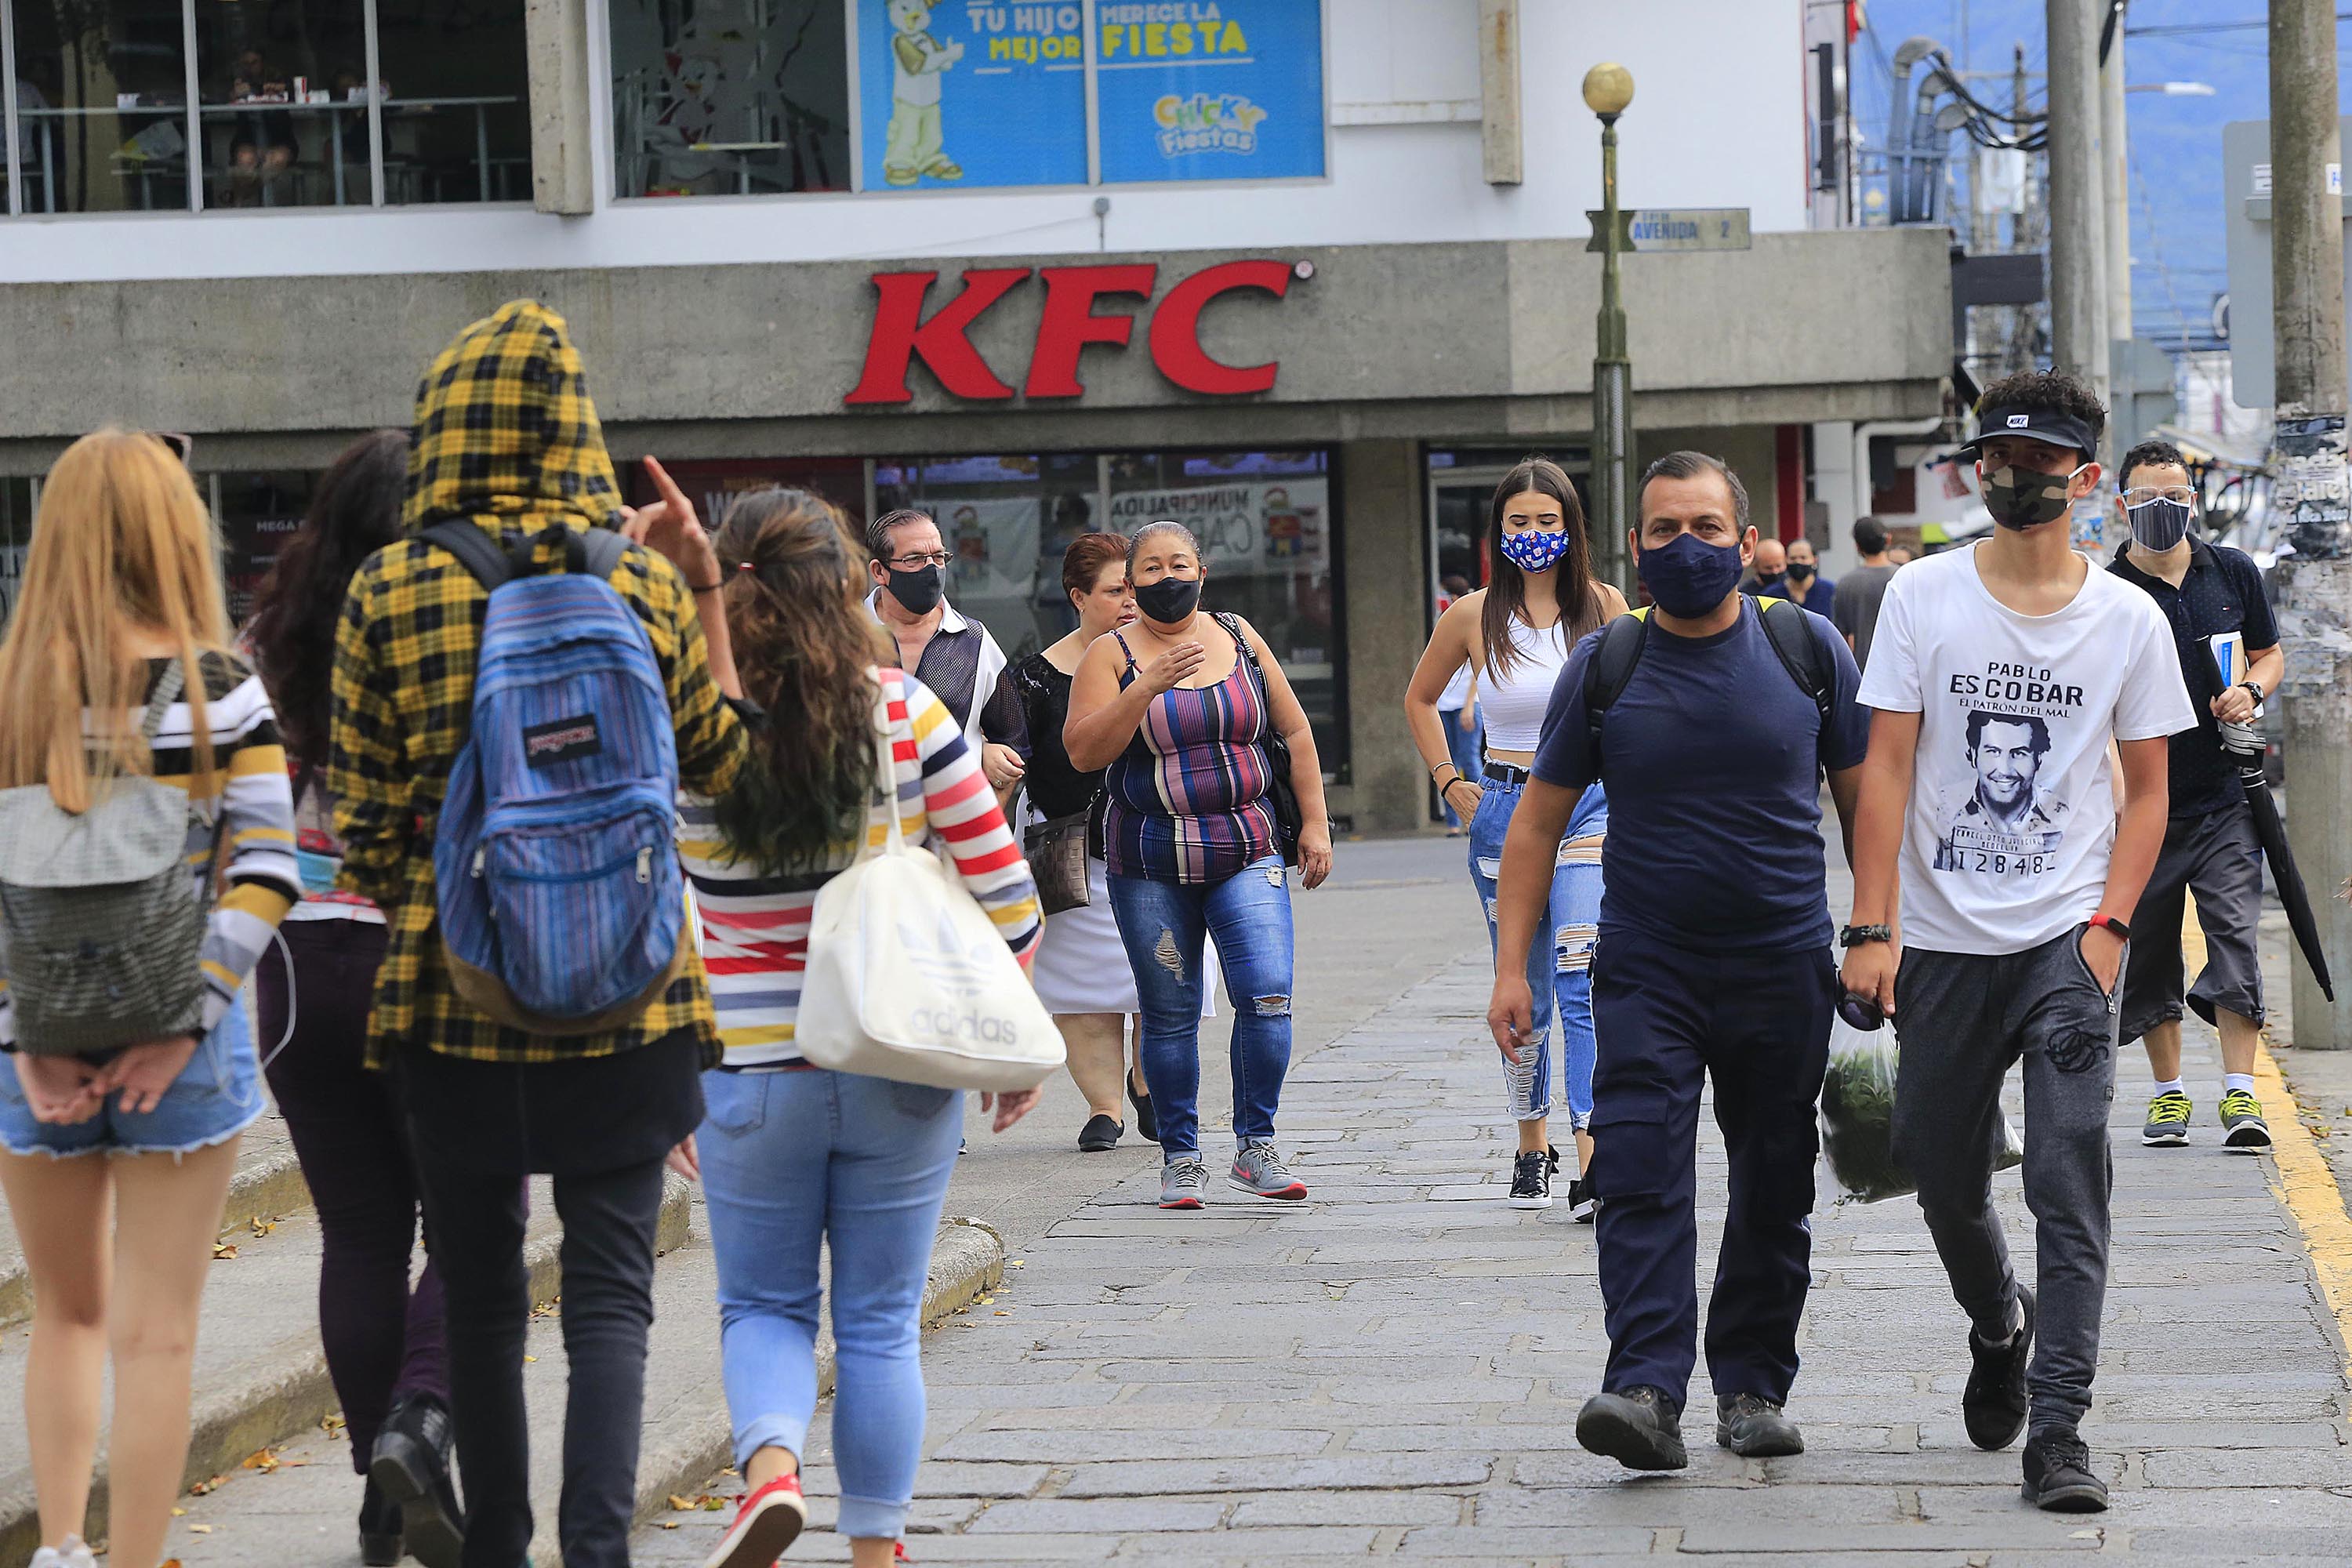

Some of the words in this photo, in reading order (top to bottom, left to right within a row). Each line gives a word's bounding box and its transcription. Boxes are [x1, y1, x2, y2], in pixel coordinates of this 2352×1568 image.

[967, 7, 1006, 33] TU
[1014, 6, 1081, 35] HIJO
[1102, 4, 1185, 24] MERECE
[1190, 2, 1221, 21] LA
[989, 36, 1081, 64] MEJOR
[1102, 20, 1248, 57] FIESTA
[1161, 125, 1253, 154] Fiestas
[1634, 221, 1698, 239] AVENIDA
[1720, 220, 1731, 238] 2
[844, 260, 1292, 404] KFC
[256, 521, 296, 532] MEGA
[1987, 662, 2051, 682] PABLO
[1950, 674, 2083, 706] ESCOBAR
[1960, 699, 1969, 707] EL
[1973, 700, 2017, 713] PATRÓN
[2020, 706, 2042, 716] DEL
[2045, 709, 2070, 718] MAL
[911, 1005, 1017, 1045] addas
